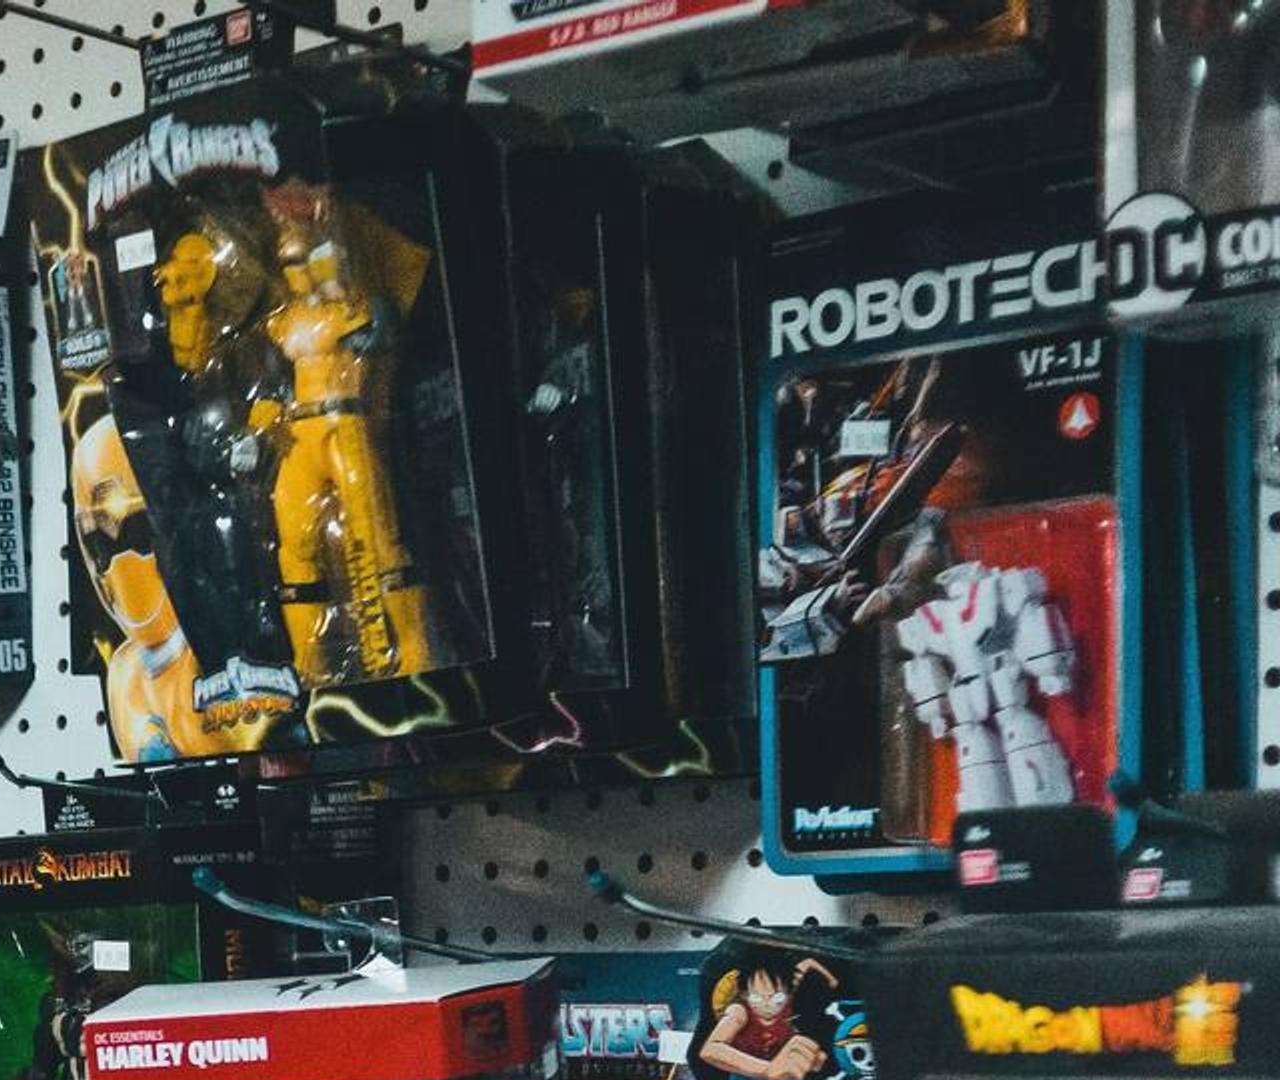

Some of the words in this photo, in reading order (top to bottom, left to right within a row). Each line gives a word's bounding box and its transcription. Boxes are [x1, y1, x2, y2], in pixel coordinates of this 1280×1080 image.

[1106, 218, 1206, 302] DC
[769, 238, 1108, 359] ROBOTECH
[1018, 337, 1103, 378] VF-1J
[54, 850, 132, 882] KOMBAT
[96, 1042, 184, 1071] HARLEY
[187, 1037, 269, 1067] QUINN
